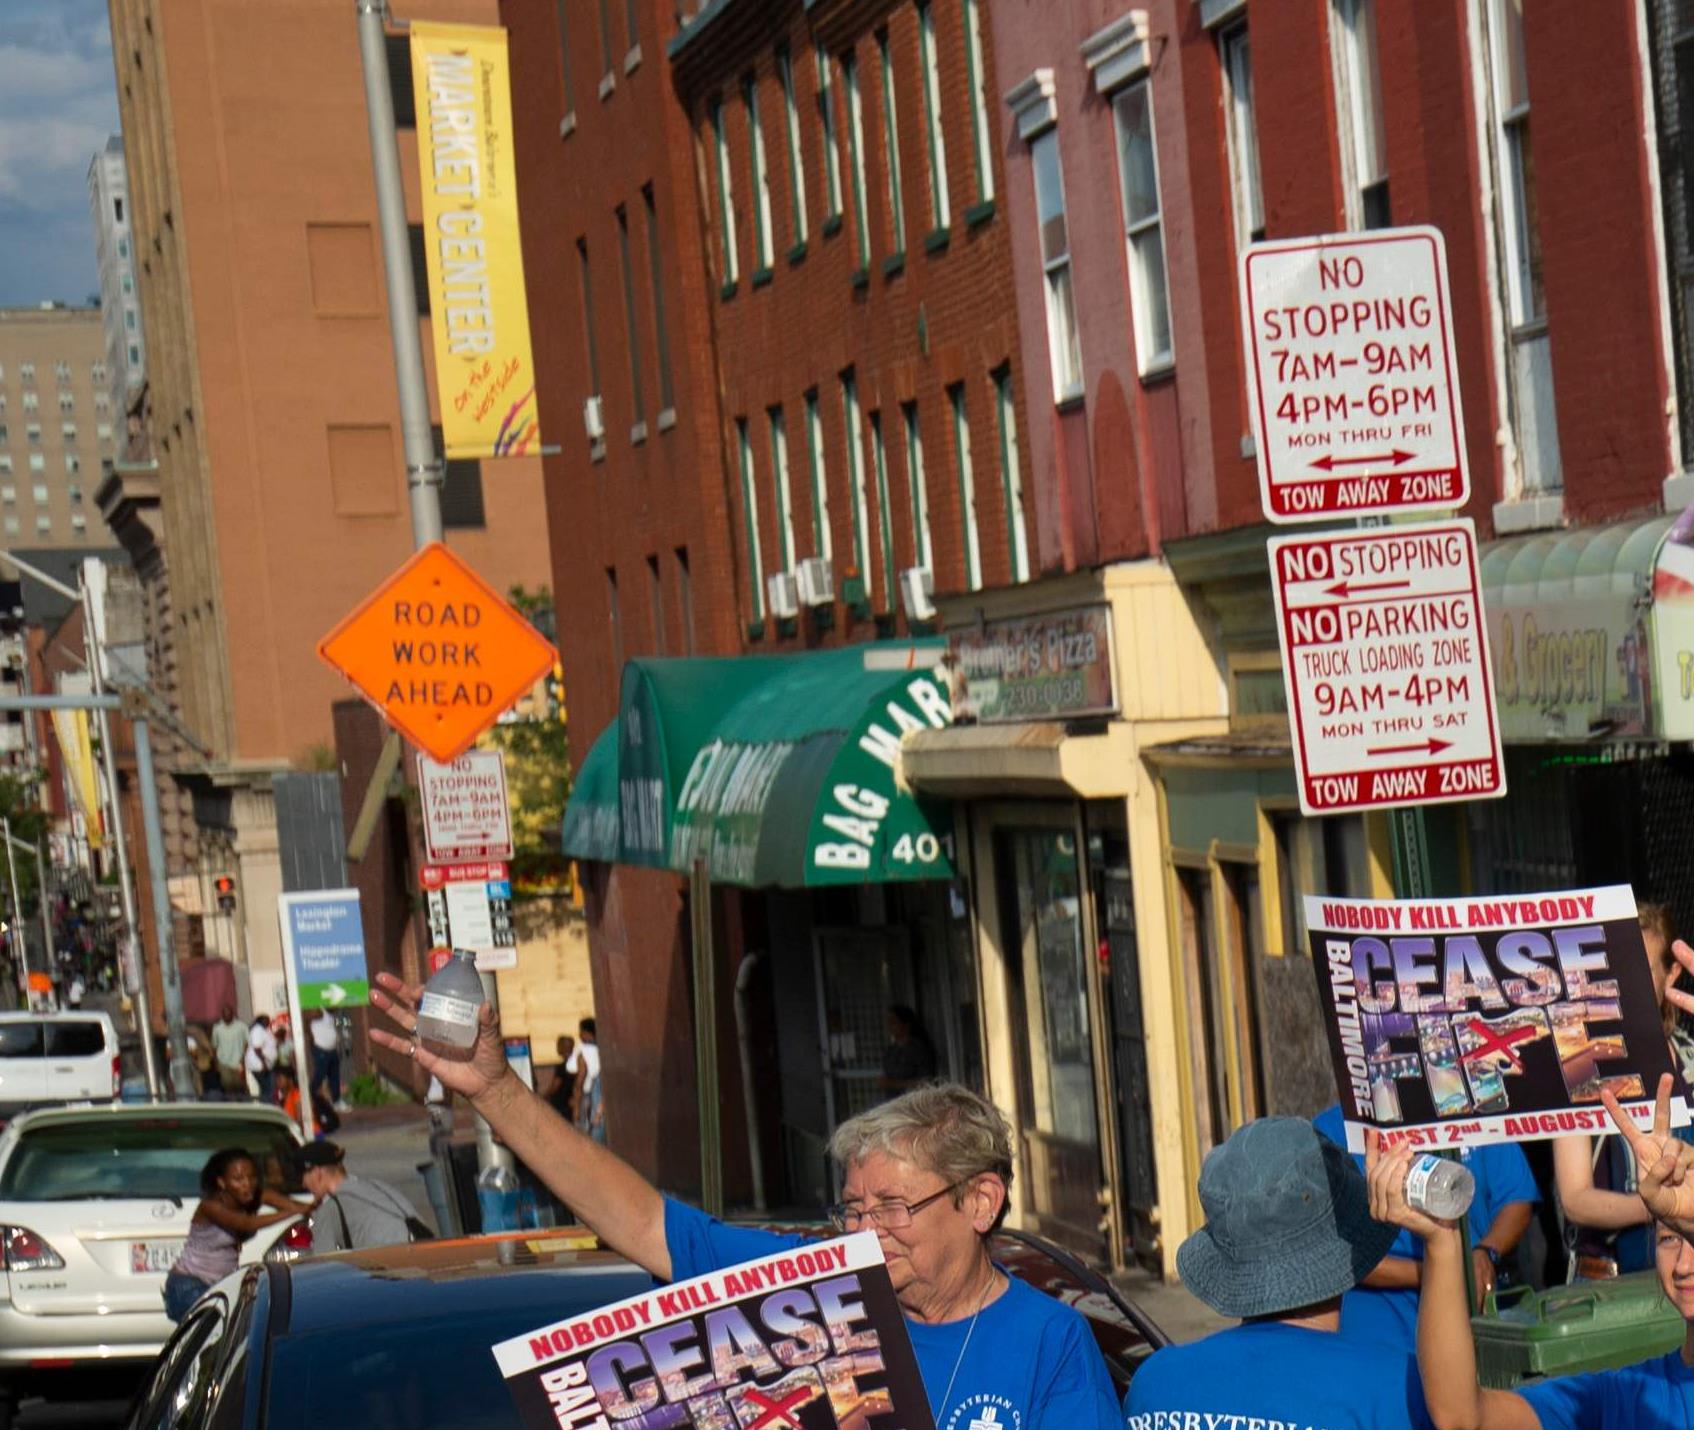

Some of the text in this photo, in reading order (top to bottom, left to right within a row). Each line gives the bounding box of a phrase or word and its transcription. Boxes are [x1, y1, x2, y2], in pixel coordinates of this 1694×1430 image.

[427, 53, 495, 354] MARKET CENTER
[1319, 256, 1363, 291] NO
[1263, 295, 1431, 341] STOPPING
[1270, 343, 1432, 383] 7AM-9AM
[1276, 384, 1436, 424] 4PM-6PM
[1288, 423, 1432, 449] MON THRU FRI
[1280, 475, 1453, 511] TOW AWAY ZONE
[1283, 536, 1462, 582] NO STOPPING
[394, 602, 480, 627] ROAD
[1291, 600, 1469, 643] NO PARKING
[392, 640, 480, 667] WORK
[1047, 628, 1096, 672] Pizza
[1302, 638, 1472, 679] TRUCK LOADING ZONE
[1523, 611, 1608, 720] Grocery
[386, 680, 493, 707] AHEAD
[1315, 674, 1470, 716] 9AM-4PM
[1322, 711, 1469, 738] MON THRU SAT
[430, 774, 497, 791] STOPPING
[1312, 764, 1494, 805] TOW AWAY ZONE
[814, 784, 890, 869] BAG
[1322, 895, 1596, 929] NOBODY KILL ANYBODY
[1350, 926, 1620, 1014] CEASE
[1325, 939, 1375, 1118] BALTIMORE
[1444, 1121, 1481, 1142] 2nd
[1505, 1109, 1607, 1136] AUGUST
[529, 1244, 849, 1361] NOBODY KILL ANYBODY
[586, 1274, 887, 1420] CEASE
